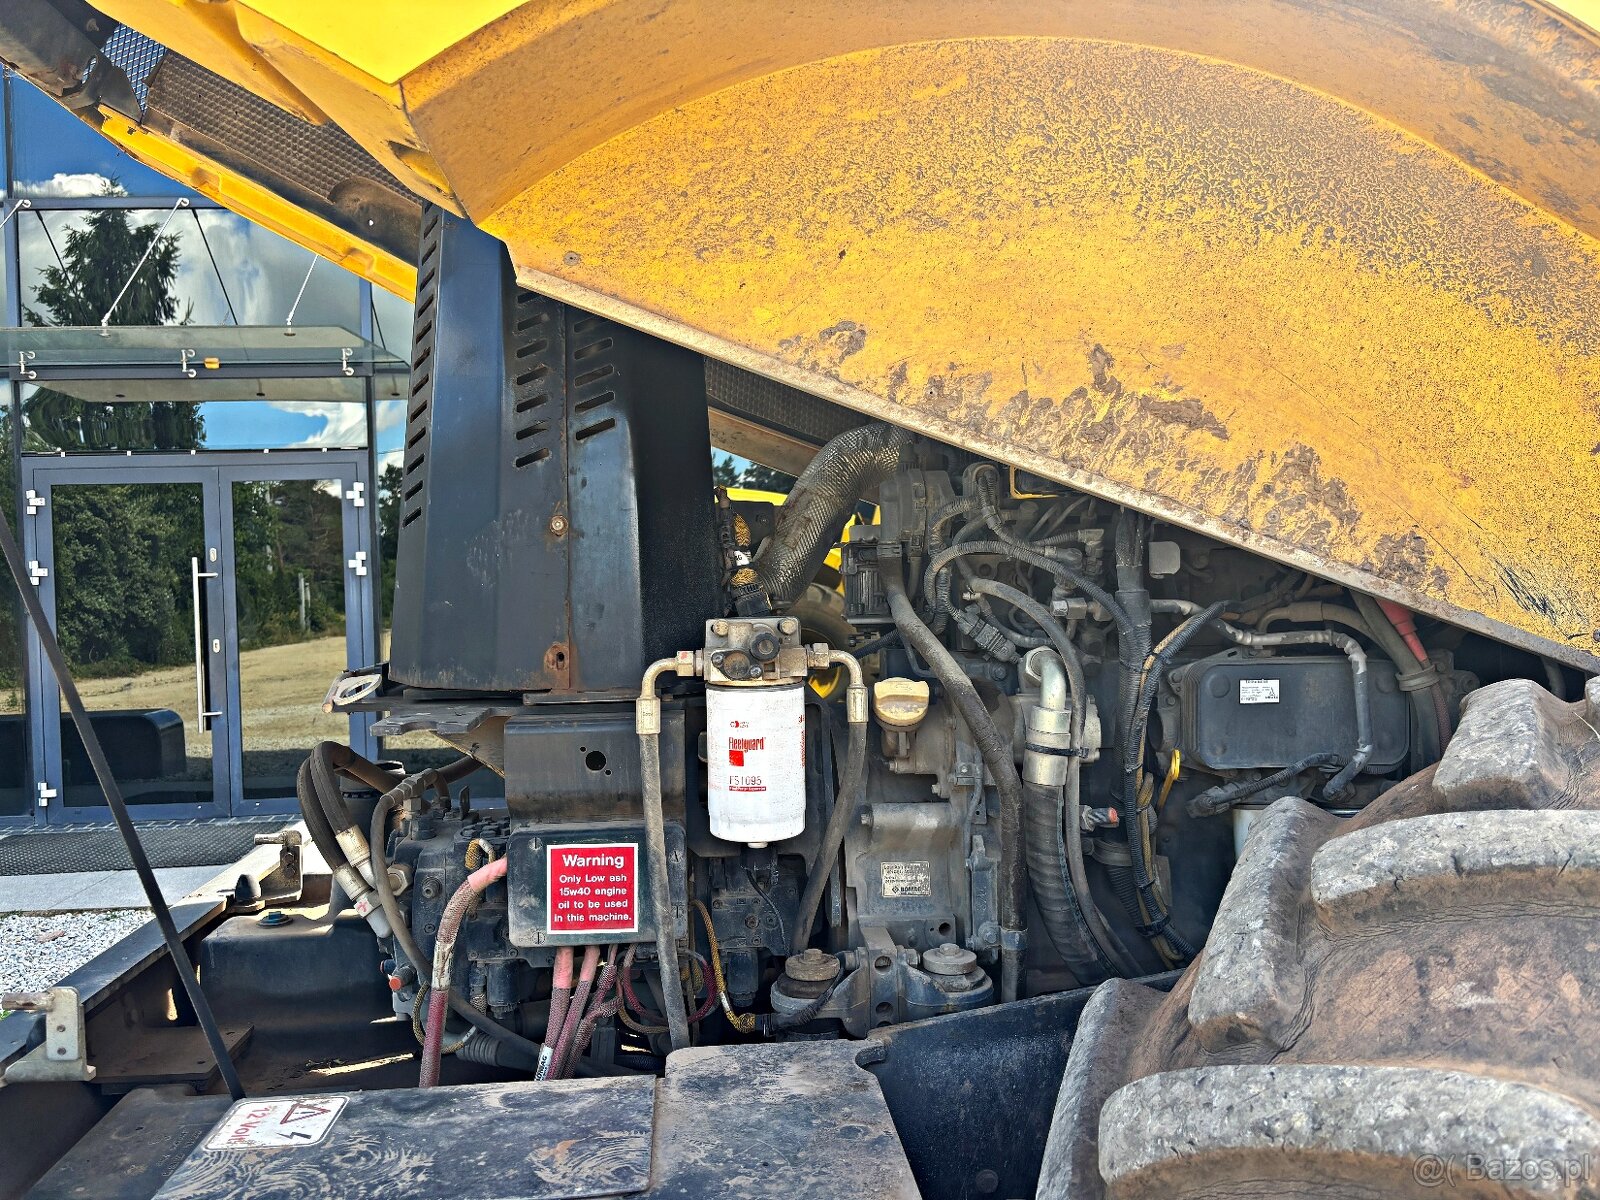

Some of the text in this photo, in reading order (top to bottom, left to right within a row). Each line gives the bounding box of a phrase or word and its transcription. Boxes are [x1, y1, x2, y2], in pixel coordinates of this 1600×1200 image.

[562, 854, 624, 868] Warning
[559, 874, 627, 885] Only Low ash
[559, 886, 627, 897] 15w40 engine
[558, 899, 628, 909] oil to be used
[554, 912, 632, 922] in this machine.
